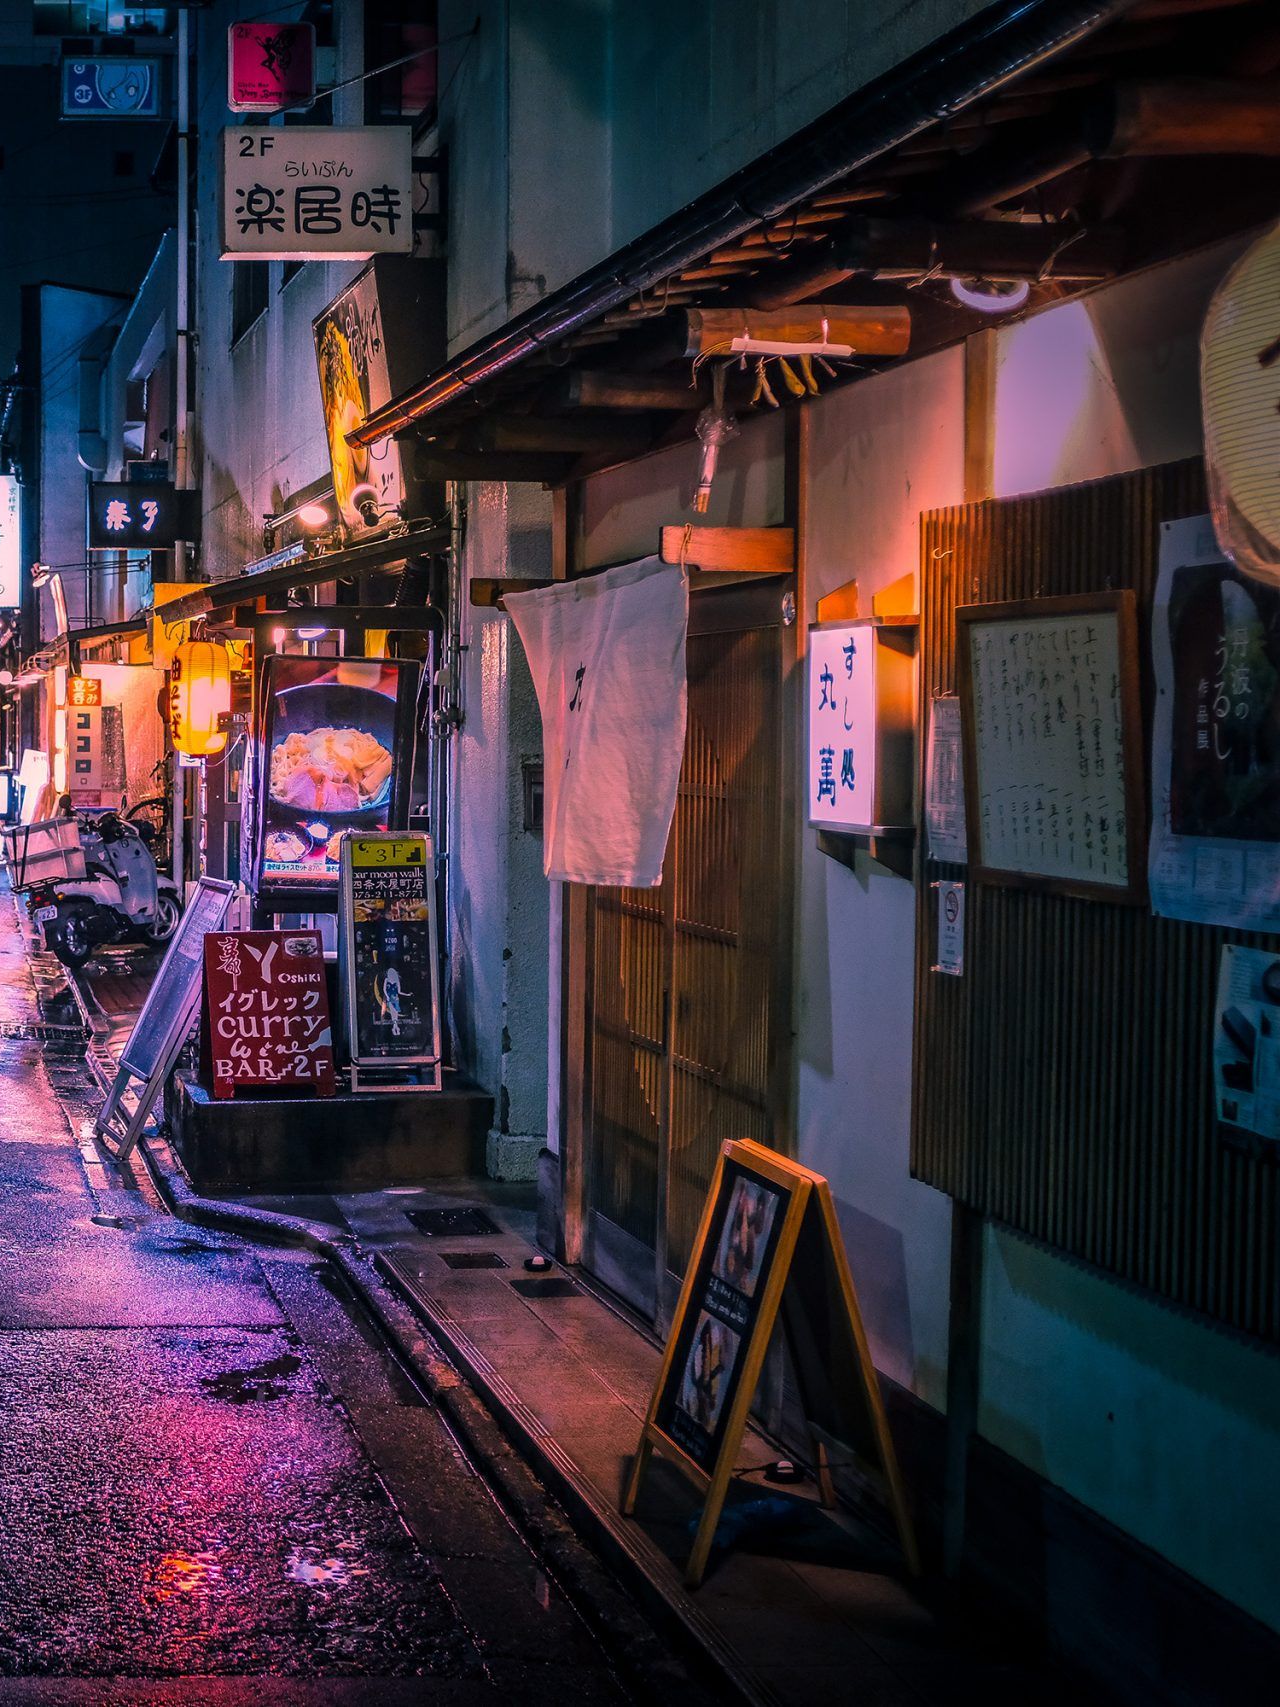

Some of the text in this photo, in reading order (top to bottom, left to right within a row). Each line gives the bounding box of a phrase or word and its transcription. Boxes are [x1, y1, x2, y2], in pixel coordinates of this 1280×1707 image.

[74, 88, 92, 100] 3F
[239, 136, 275, 157] 2F
[285, 161, 354, 178] らいぷん
[235, 183, 402, 236] 楽居時
[840, 637, 856, 791] すし処
[816, 663, 836, 807] 丸萬
[399, 867, 424, 878] walk
[353, 878, 424, 892] 四条木屋町店
[218, 989, 320, 1013] イグレック
[216, 1016, 326, 1038] curry
[215, 1056, 328, 1077] BAR 2F
